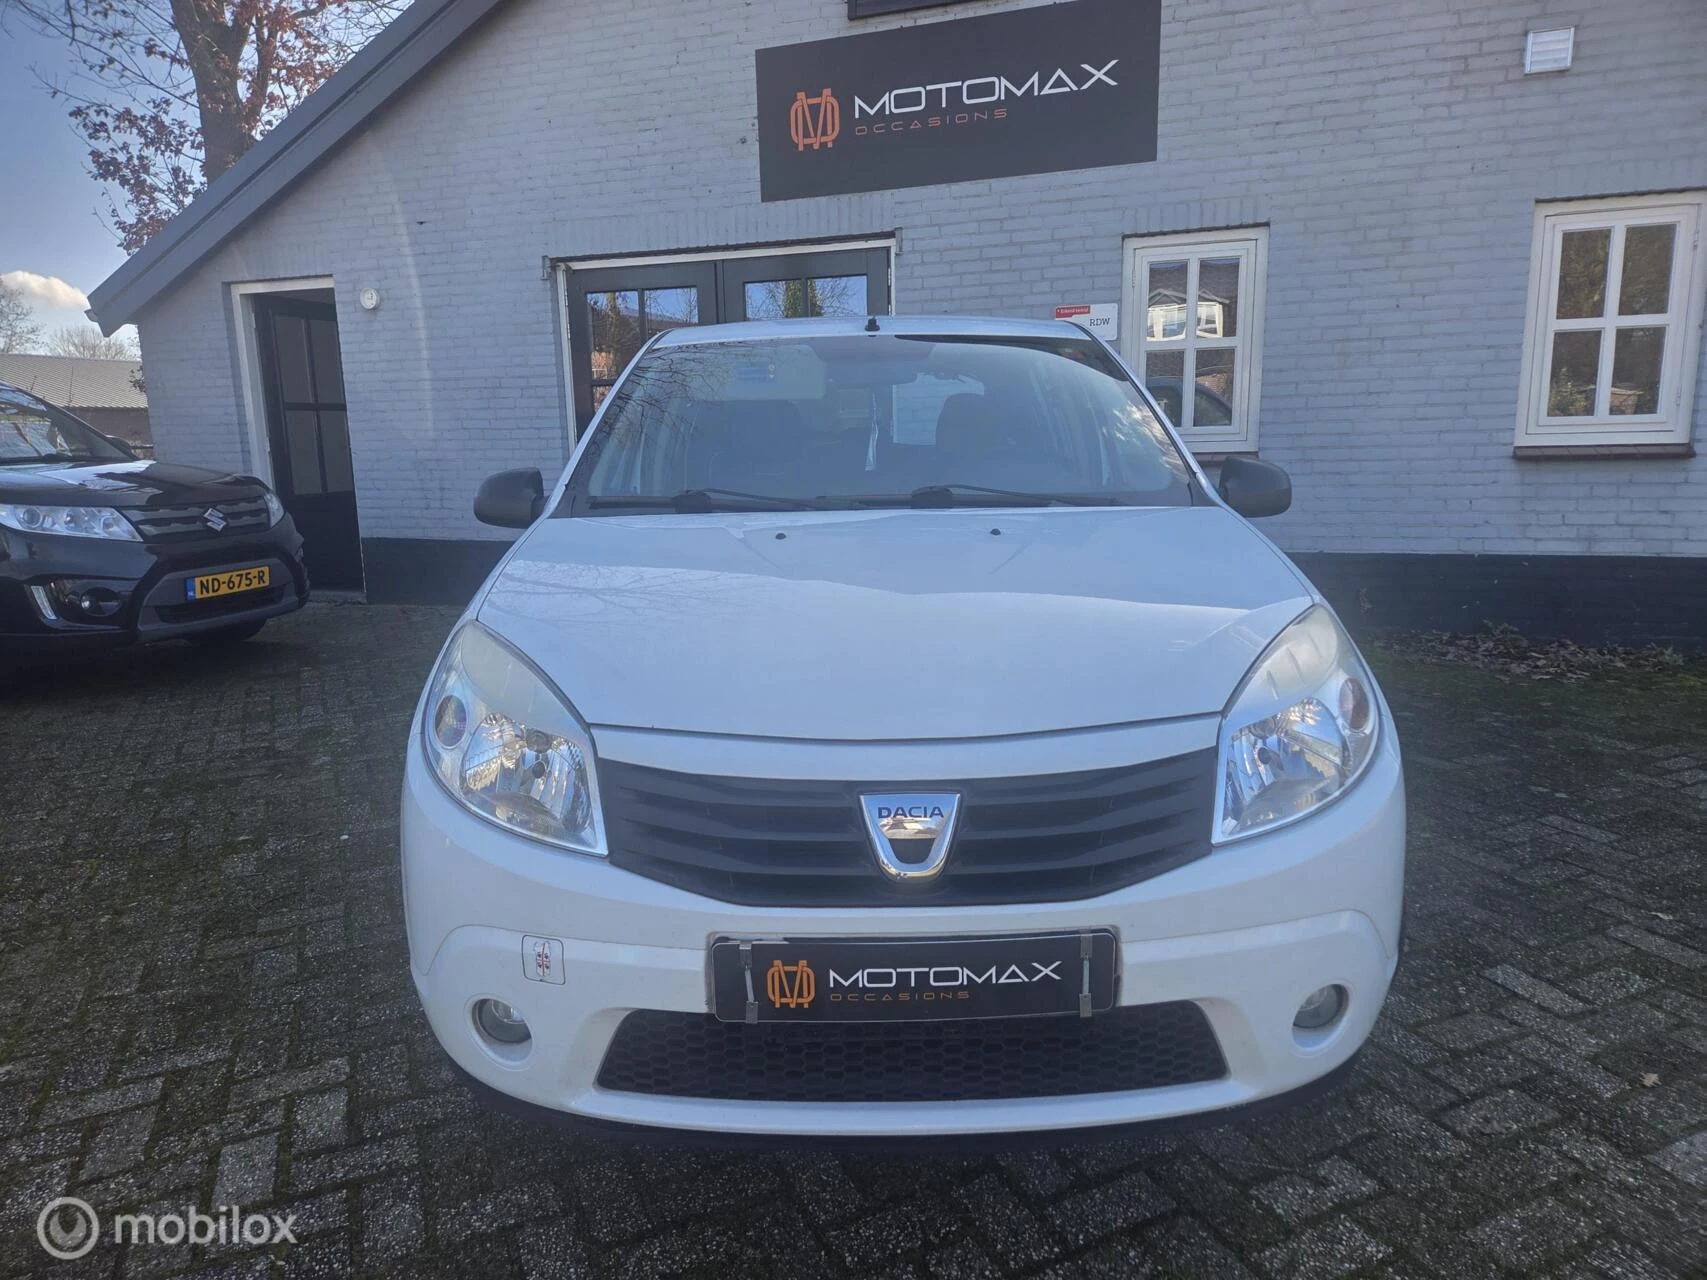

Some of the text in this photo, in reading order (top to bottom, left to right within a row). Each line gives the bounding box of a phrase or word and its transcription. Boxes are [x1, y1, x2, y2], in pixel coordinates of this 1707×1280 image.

[854, 59, 1119, 119] MOTOMAX
[855, 108, 1008, 135] OCCASIONS
[1089, 318, 1111, 327] RDW
[200, 570, 266, 595] ND-675-R
[877, 806, 944, 818] DACIA
[829, 961, 1062, 988] MOTOMAX
[830, 991, 970, 1001] OCCASIONS
